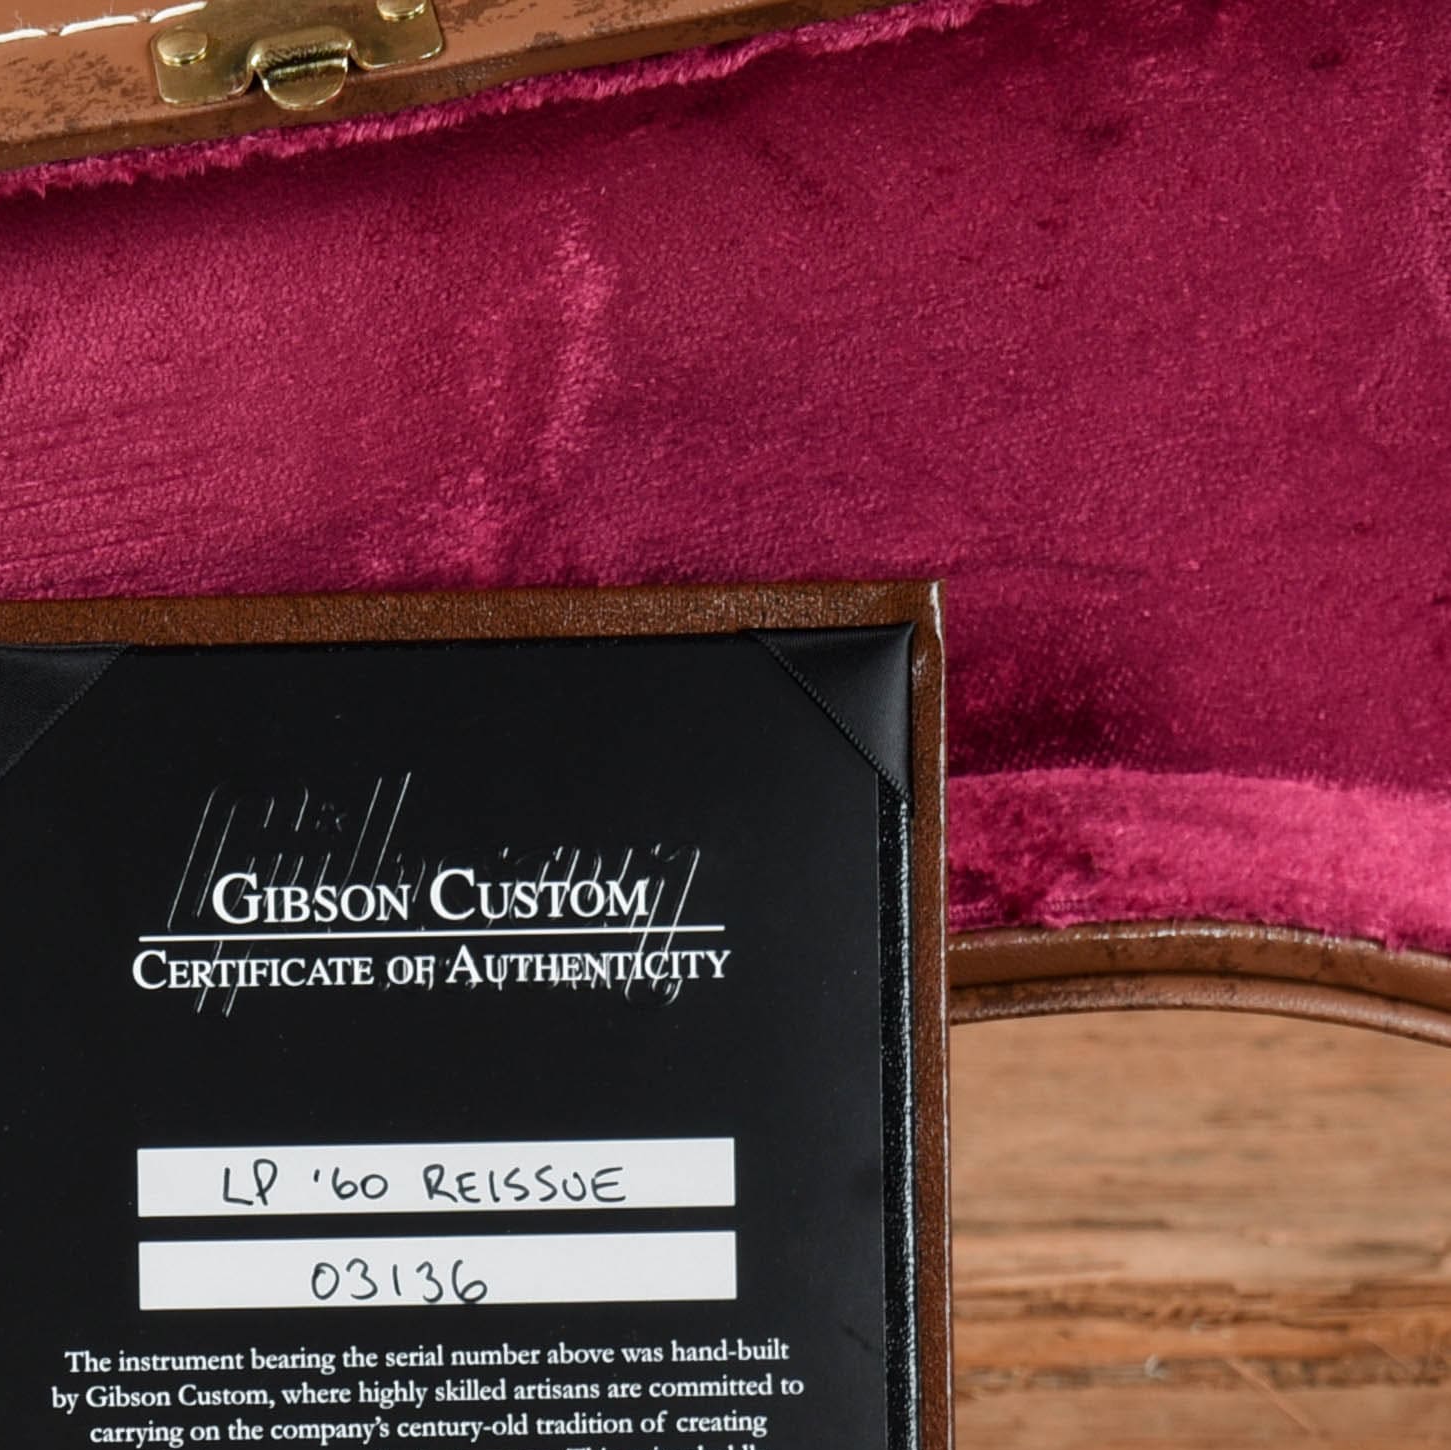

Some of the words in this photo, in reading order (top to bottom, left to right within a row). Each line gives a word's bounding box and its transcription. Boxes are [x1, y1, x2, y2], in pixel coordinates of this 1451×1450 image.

[211, 871, 412, 927] GIBSON
[429, 867, 651, 925] CUSTOM
[131, 948, 376, 993] CERTIFICATE
[386, 953, 436, 988] OF
[446, 942, 733, 987] AUTHENTICITY
[222, 1161, 278, 1207] LP
[422, 1162, 627, 1204] REISSUE
[310, 1258, 492, 1306] 03136
[63, 1349, 112, 1374] The
[118, 1348, 245, 1373] instrument
[250, 1346, 337, 1376] bearing
[342, 1344, 379, 1369] the
[385, 1343, 445, 1369] serial
[450, 1341, 541, 1367] number
[546, 1340, 615, 1366] above
[620, 1345, 664, 1364] was
[670, 1337, 790, 1363] hand-built
[51, 1385, 80, 1414] by
[85, 1384, 172, 1409] Gibson
[177, 1383, 276, 1410] Custom,
[280, 1380, 352, 1406] where
[358, 1378, 429, 1410] highly
[434, 1377, 507, 1403] skilled
[513, 1376, 601, 1402] artisans
[607, 1382, 642, 1399] are
[648, 1371, 774, 1399] committed
[780, 1377, 805, 1396] to
